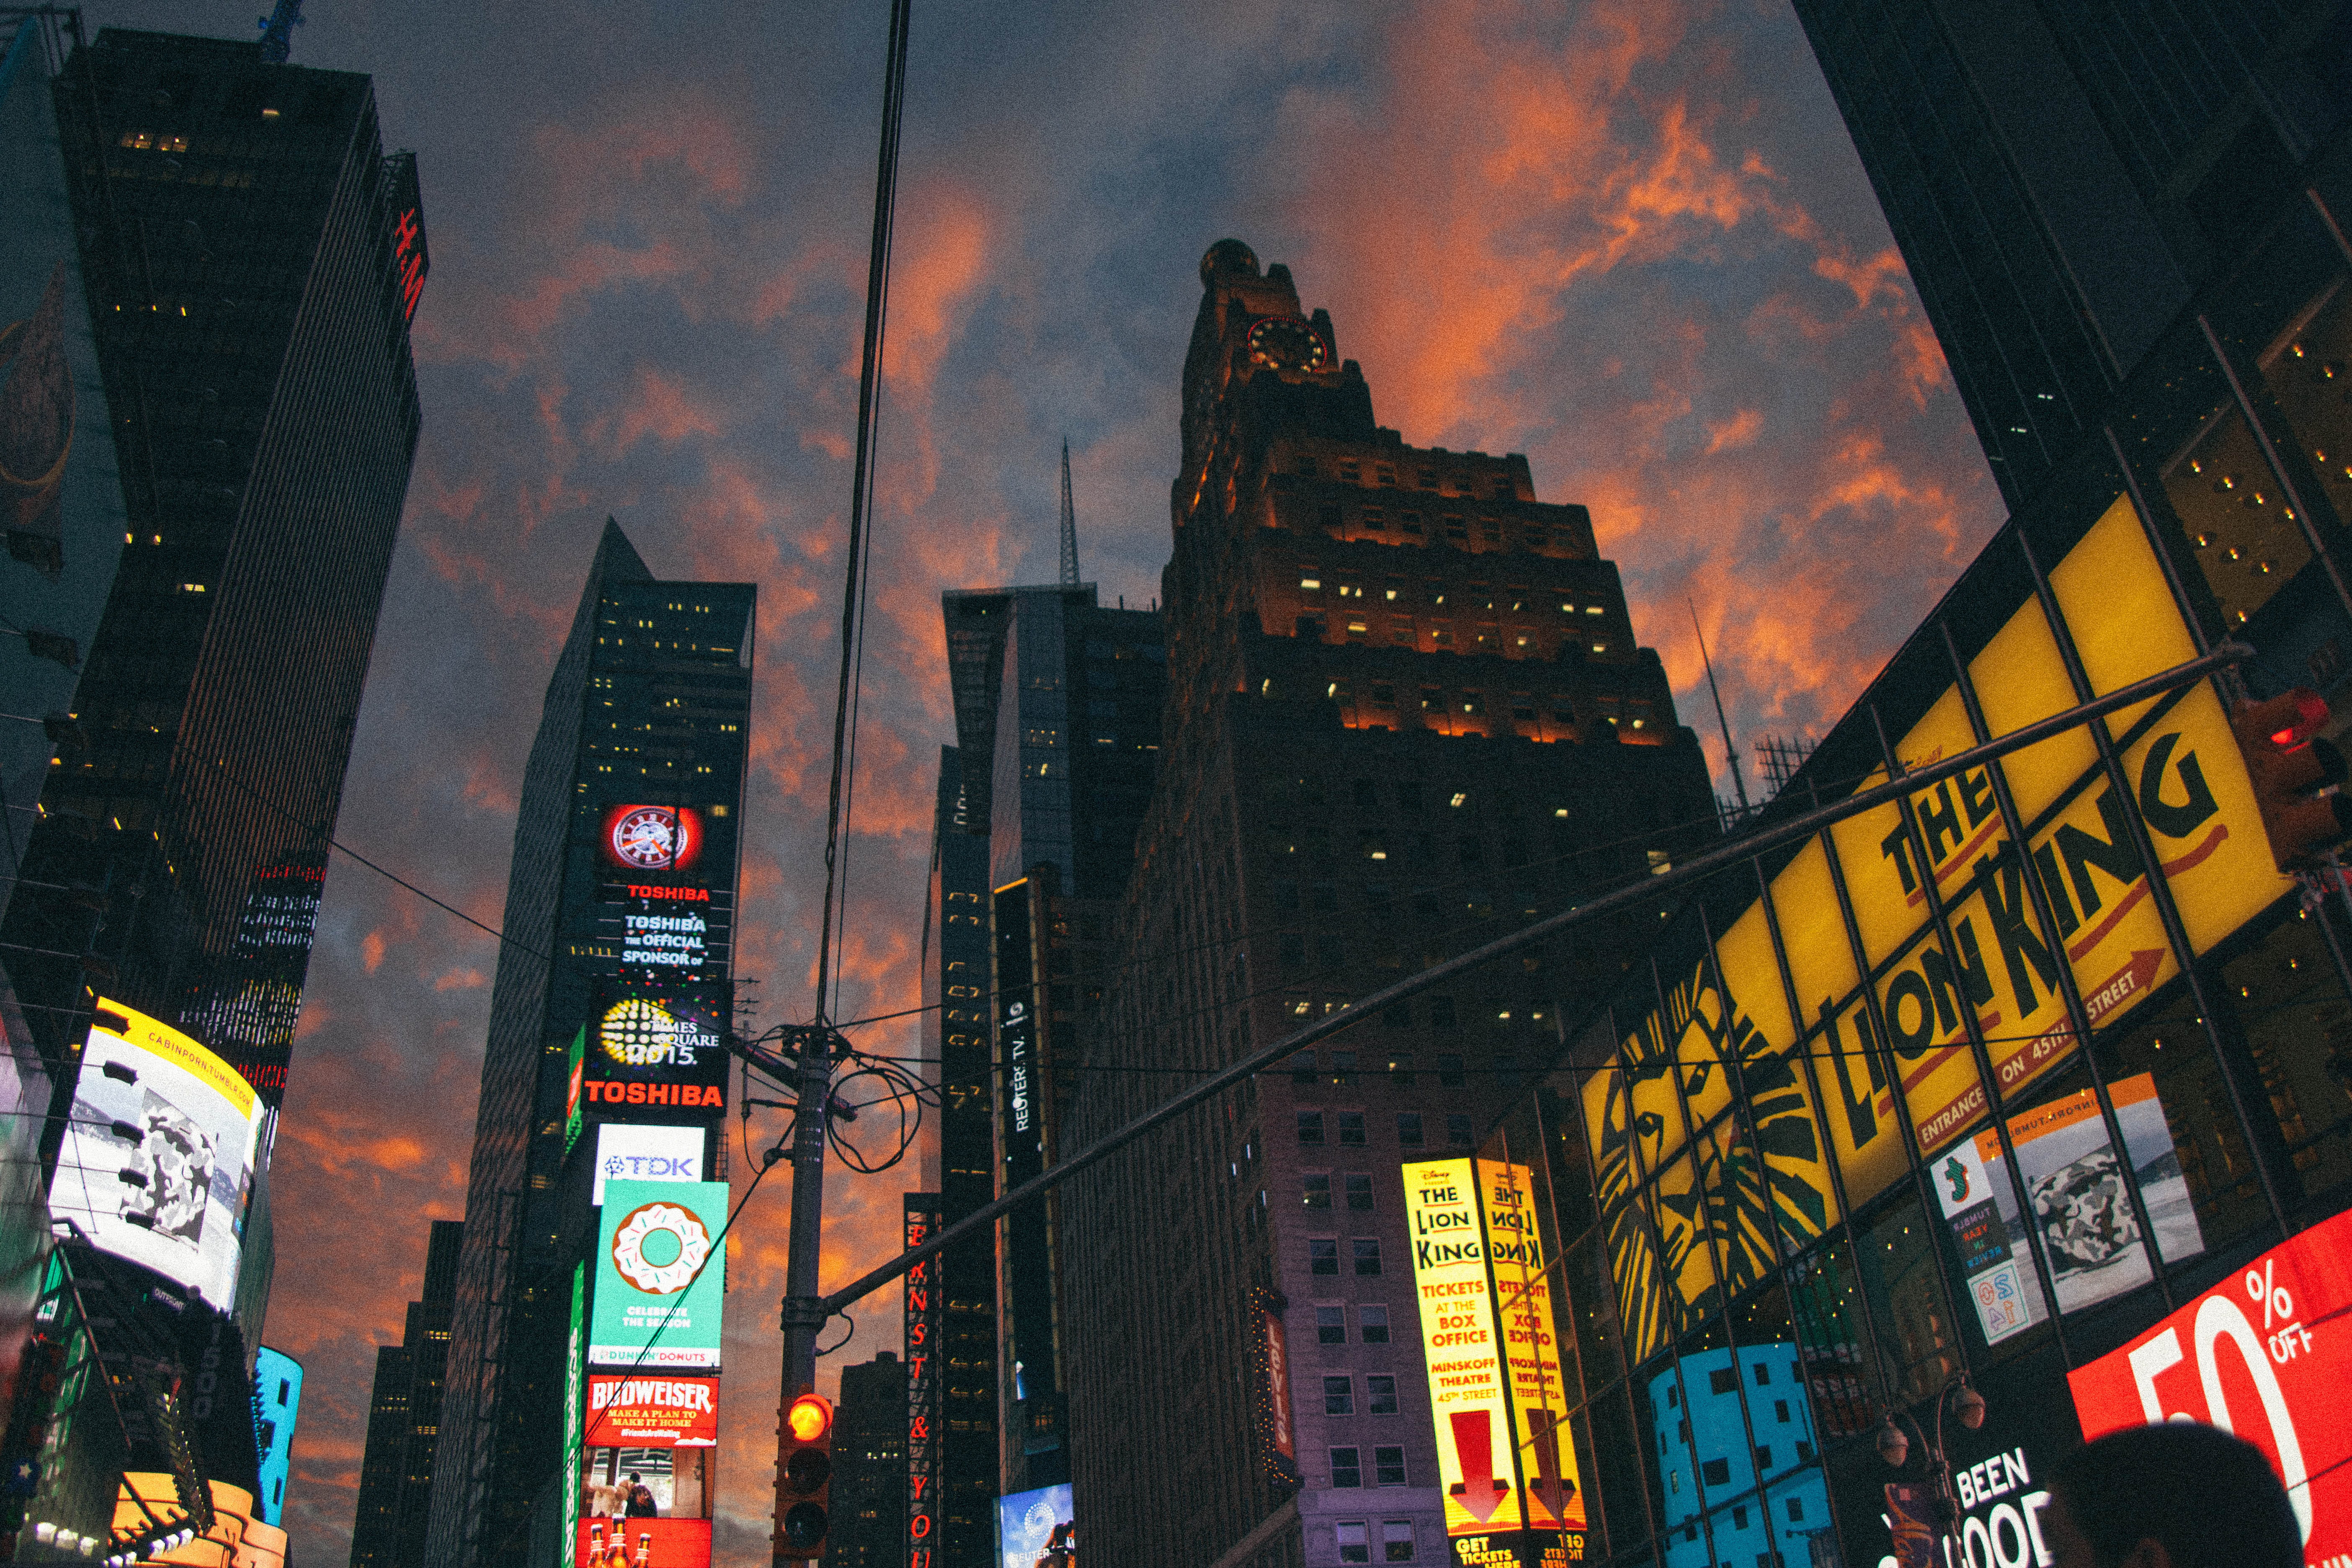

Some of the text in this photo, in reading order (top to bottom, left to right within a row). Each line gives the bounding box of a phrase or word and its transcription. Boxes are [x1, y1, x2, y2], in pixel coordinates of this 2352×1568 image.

[1881, 769, 1996, 896] THE
[627, 885, 709, 901] TOSHIBA
[624, 916, 707, 932] TOSHIBA
[624, 934, 704, 949] THE OFFICIAL
[1818, 732, 2220, 1151] LION KING
[622, 951, 703, 966] SPONSOR OF
[650, 1020, 698, 1033] TIMES
[656, 1033, 719, 1047] SQUARE
[1921, 970, 2136, 1144] ENTRANCE ON 45TH STREET
[149, 1032, 250, 1106] CABINPORN.TUMBLR.COM
[585, 1081, 723, 1107] TOSHIBA
[626, 1156, 693, 1176] TDK
[1419, 1186, 1458, 1204] THE
[1416, 1210, 1469, 1235] LION
[1416, 1240, 1480, 1270] KING
[1421, 1280, 1484, 1298] TICKETS
[1436, 1300, 1475, 1313] AT THE
[622, 1317, 643, 1327] THE
[1439, 1314, 1476, 1330] BOX
[1432, 1330, 1488, 1347] OFFICE
[2267, 1326, 2313, 1364] OFF
[659, 1352, 706, 1362] DONUTS
[1431, 1358, 1496, 1374] MINSKOFF
[1439, 1374, 1491, 1387] THEATRE
[592, 1381, 712, 1414] BUDWEISER
[1463, 1388, 1497, 1400] STREET
[608, 1409, 640, 1418] MAKE
[910, 1416, 929, 1439] &
[1955, 1446, 2031, 1510] BEEN
[1455, 1537, 1489, 1555] GET
[1460, 1549, 1513, 1565] TICKETS
